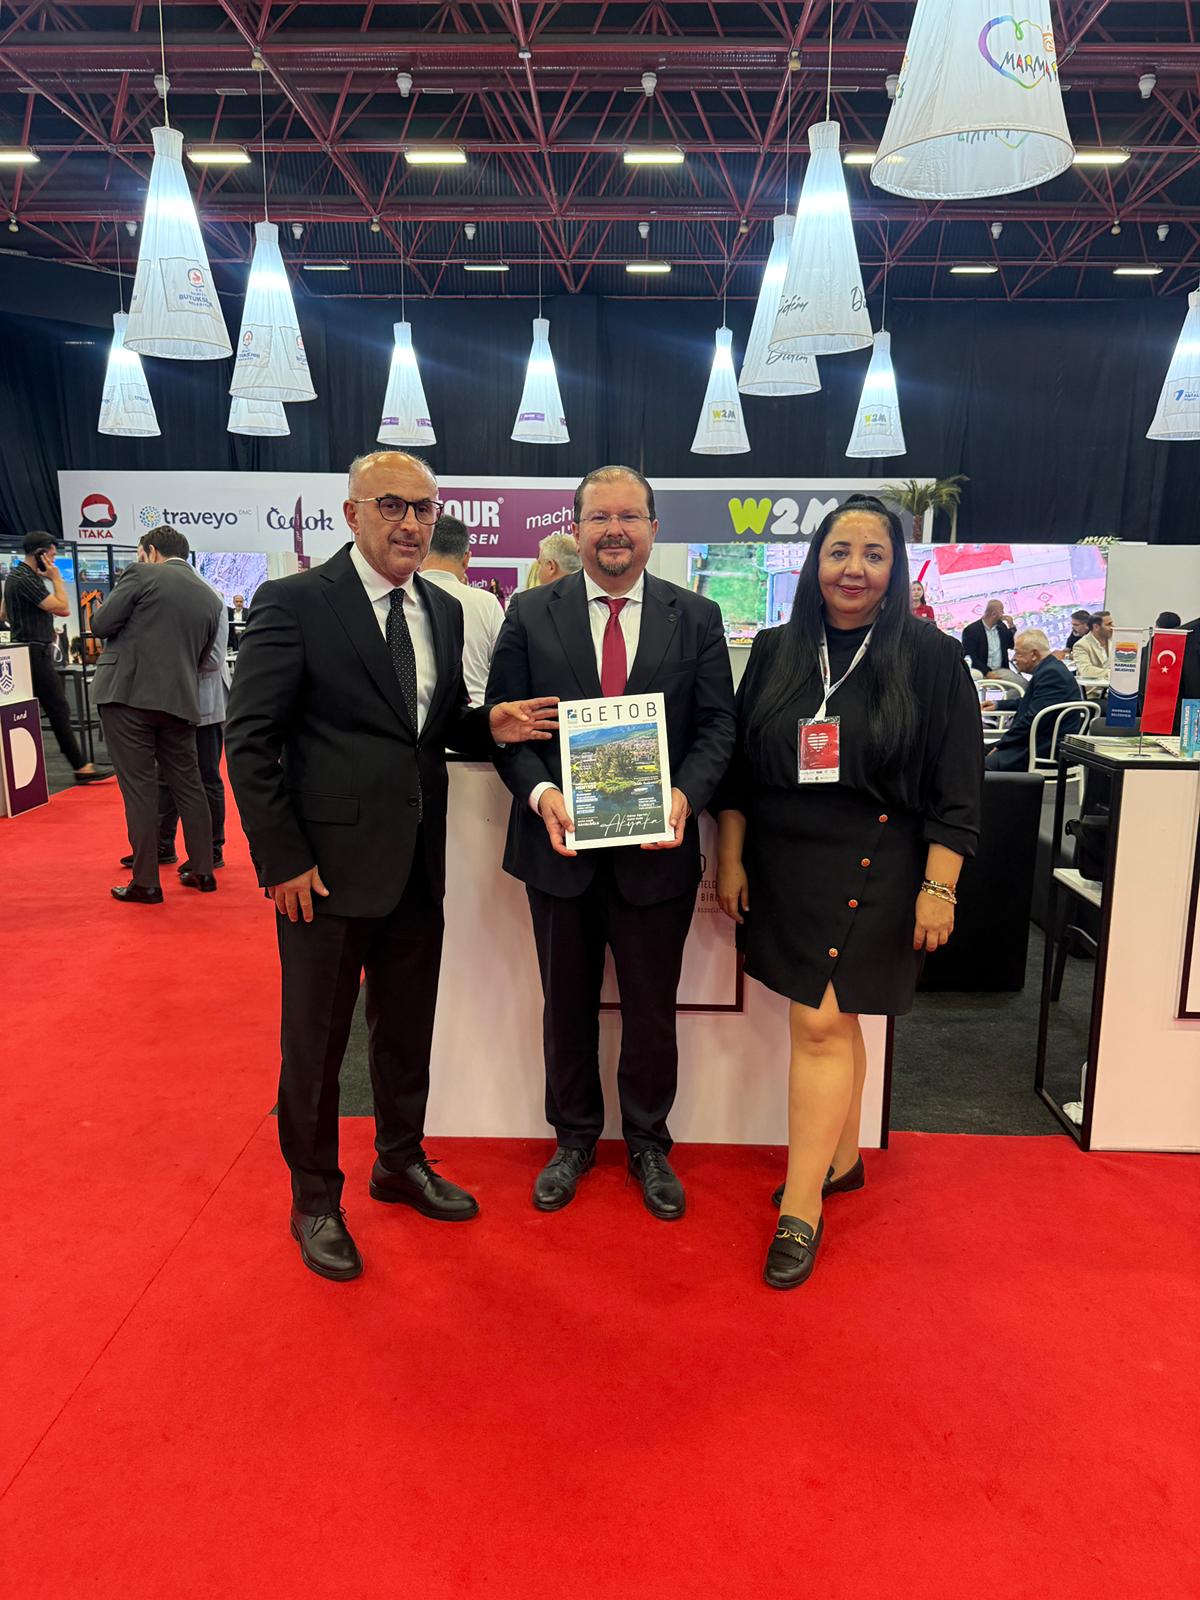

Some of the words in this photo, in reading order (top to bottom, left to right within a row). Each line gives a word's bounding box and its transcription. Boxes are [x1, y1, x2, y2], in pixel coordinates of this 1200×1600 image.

[163, 508, 238, 530] traveyo
[728, 497, 840, 536] W2M
[78, 529, 114, 540] ITAKA
[581, 701, 657, 723] GETOB
